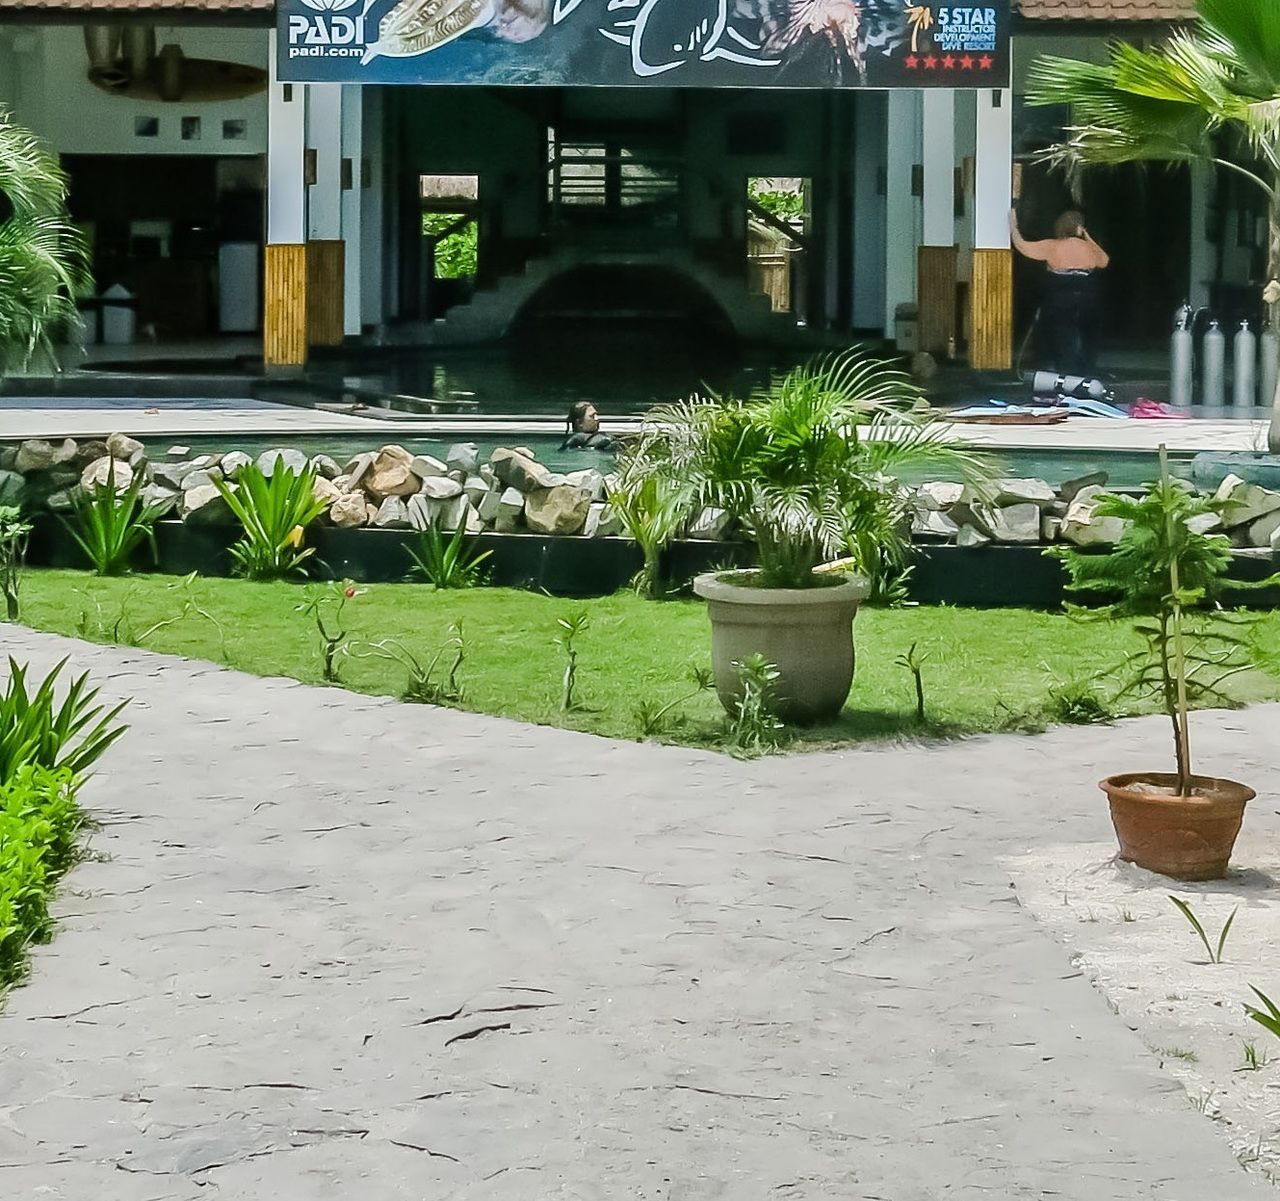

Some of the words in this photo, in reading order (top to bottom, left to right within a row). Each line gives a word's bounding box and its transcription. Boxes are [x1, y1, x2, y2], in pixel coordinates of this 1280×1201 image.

[938, 7, 950, 25] 5
[952, 7, 996, 25] STAR
[289, 15, 364, 44] PADI
[943, 25, 996, 33] INSTRUCTOR
[934, 33, 995, 42] DEVELOPMENT
[289, 46, 363, 58] padi.com
